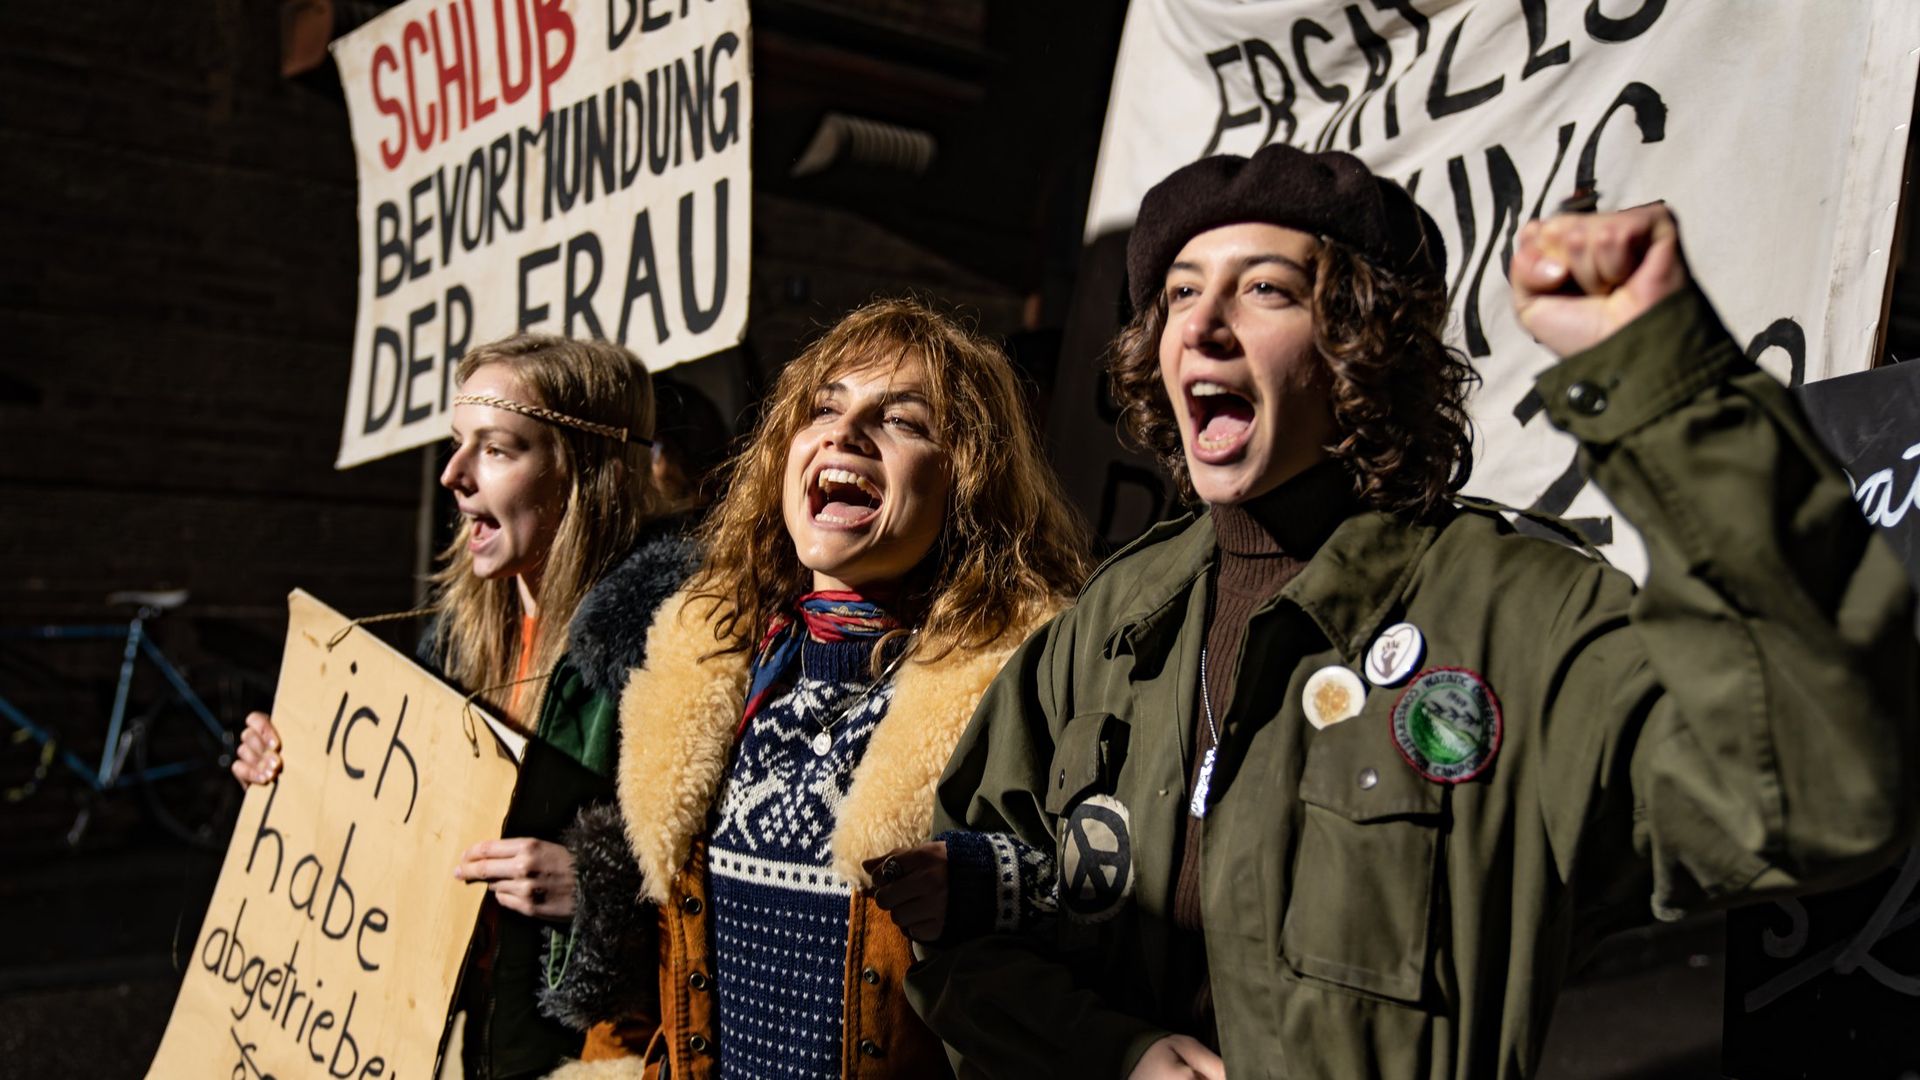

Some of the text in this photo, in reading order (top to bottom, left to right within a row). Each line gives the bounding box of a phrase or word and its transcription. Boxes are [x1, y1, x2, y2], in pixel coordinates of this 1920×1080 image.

[376, 31, 740, 299] BEVORMUNDUNG
[362, 177, 730, 436] DER FRAU
[326, 661, 419, 824] ich
[246, 780, 389, 971] habe
[201, 897, 396, 1080] abgetriebe
